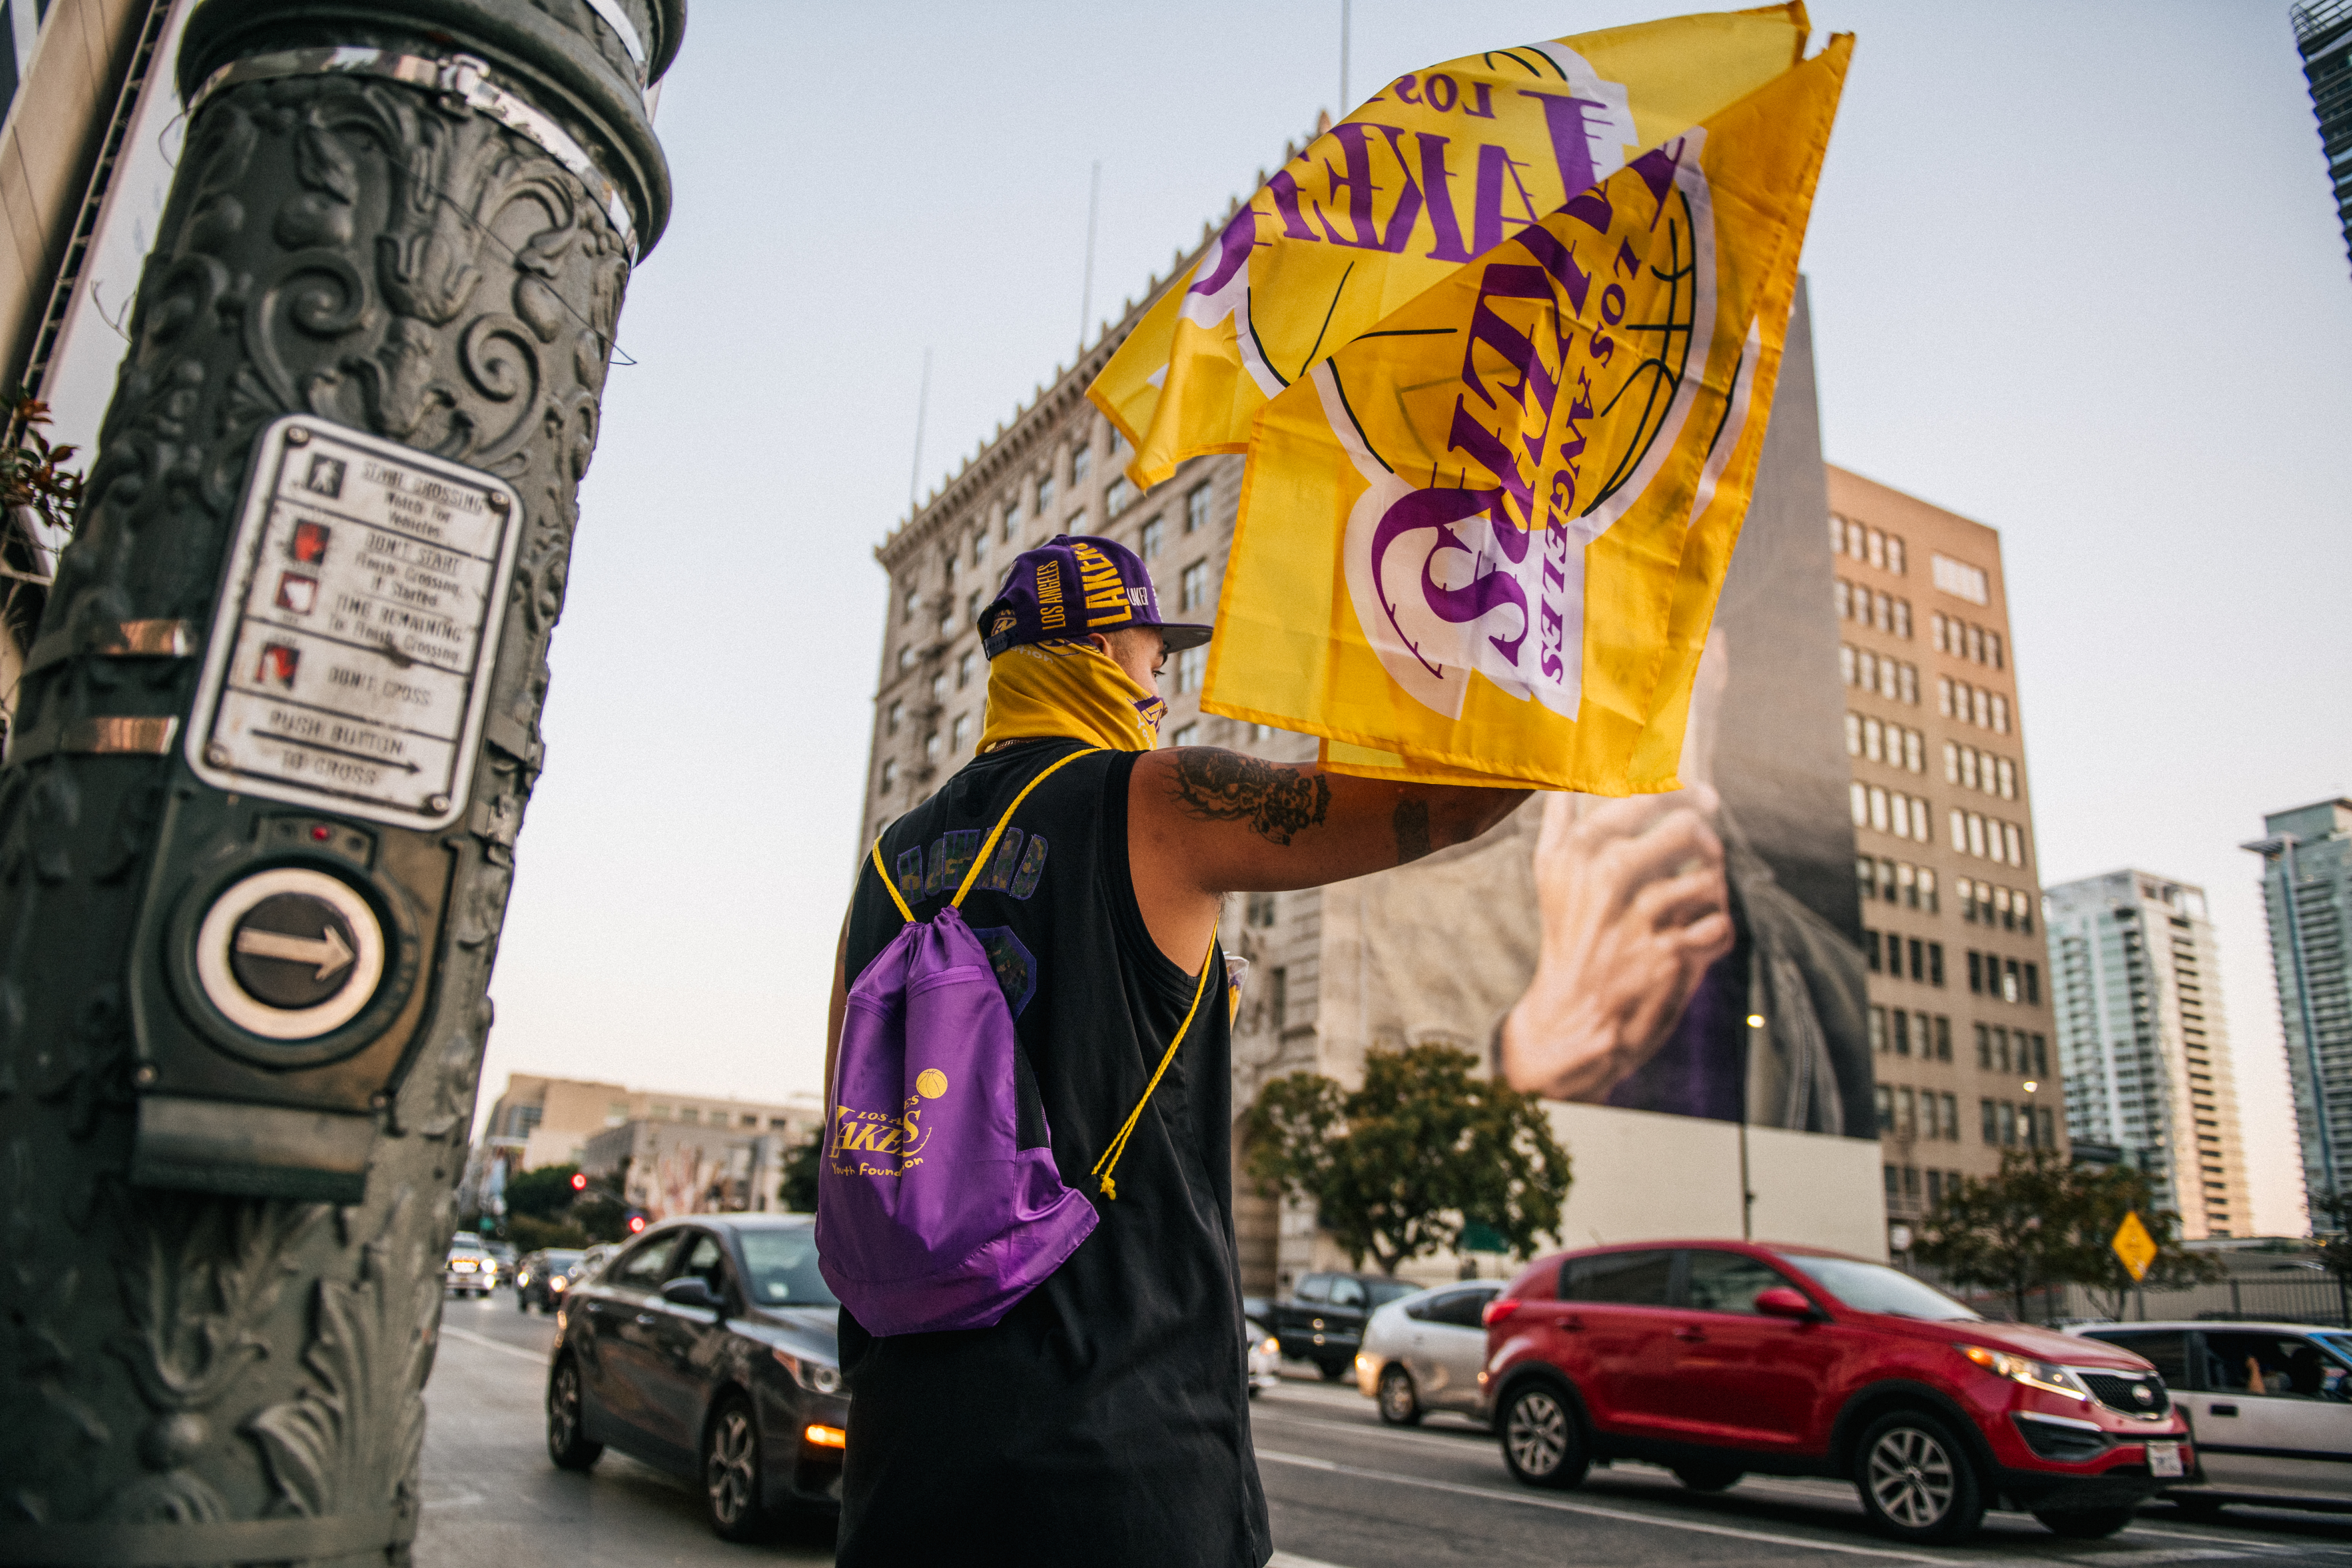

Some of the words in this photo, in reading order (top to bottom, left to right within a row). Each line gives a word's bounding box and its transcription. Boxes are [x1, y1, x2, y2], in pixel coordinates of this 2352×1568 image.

[1589, 235, 1641, 369] LOS
[414, 477, 483, 514] CROSSING
[1541, 365, 1594, 685] ANGELES
[366, 532, 409, 557] DON'T
[419, 548, 460, 574] START
[1036, 560, 1063, 604] ANGELES
[336, 593, 373, 618] TIME
[381, 607, 462, 643] REMAINING
[1040, 605, 1066, 631] LOS
[329, 666, 375, 691] DON'T
[270, 709, 322, 736] PUSH
[330, 725, 403, 756] BUTTON
[282, 750, 305, 770] TO
[314, 756, 377, 786] CROSS
[857, 1111, 888, 1121] LOS
[831, 1162, 855, 1176] Youth
